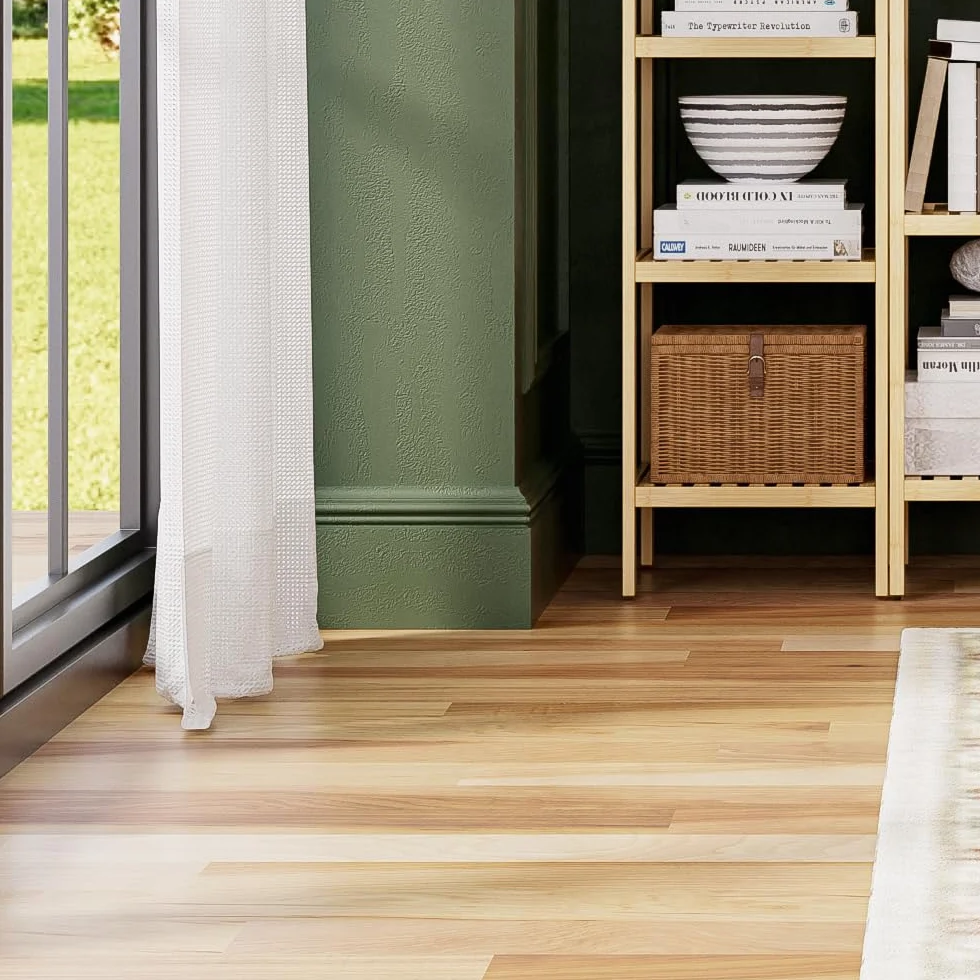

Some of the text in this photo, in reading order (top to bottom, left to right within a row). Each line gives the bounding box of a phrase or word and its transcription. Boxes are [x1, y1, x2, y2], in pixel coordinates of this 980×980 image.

[688, 21, 811, 32] The Typewriter Revolution
[696, 191, 793, 201] IN COLD BLOOD
[728, 242, 766, 252] RAUMIDEEN
[922, 361, 958, 372] Moran
